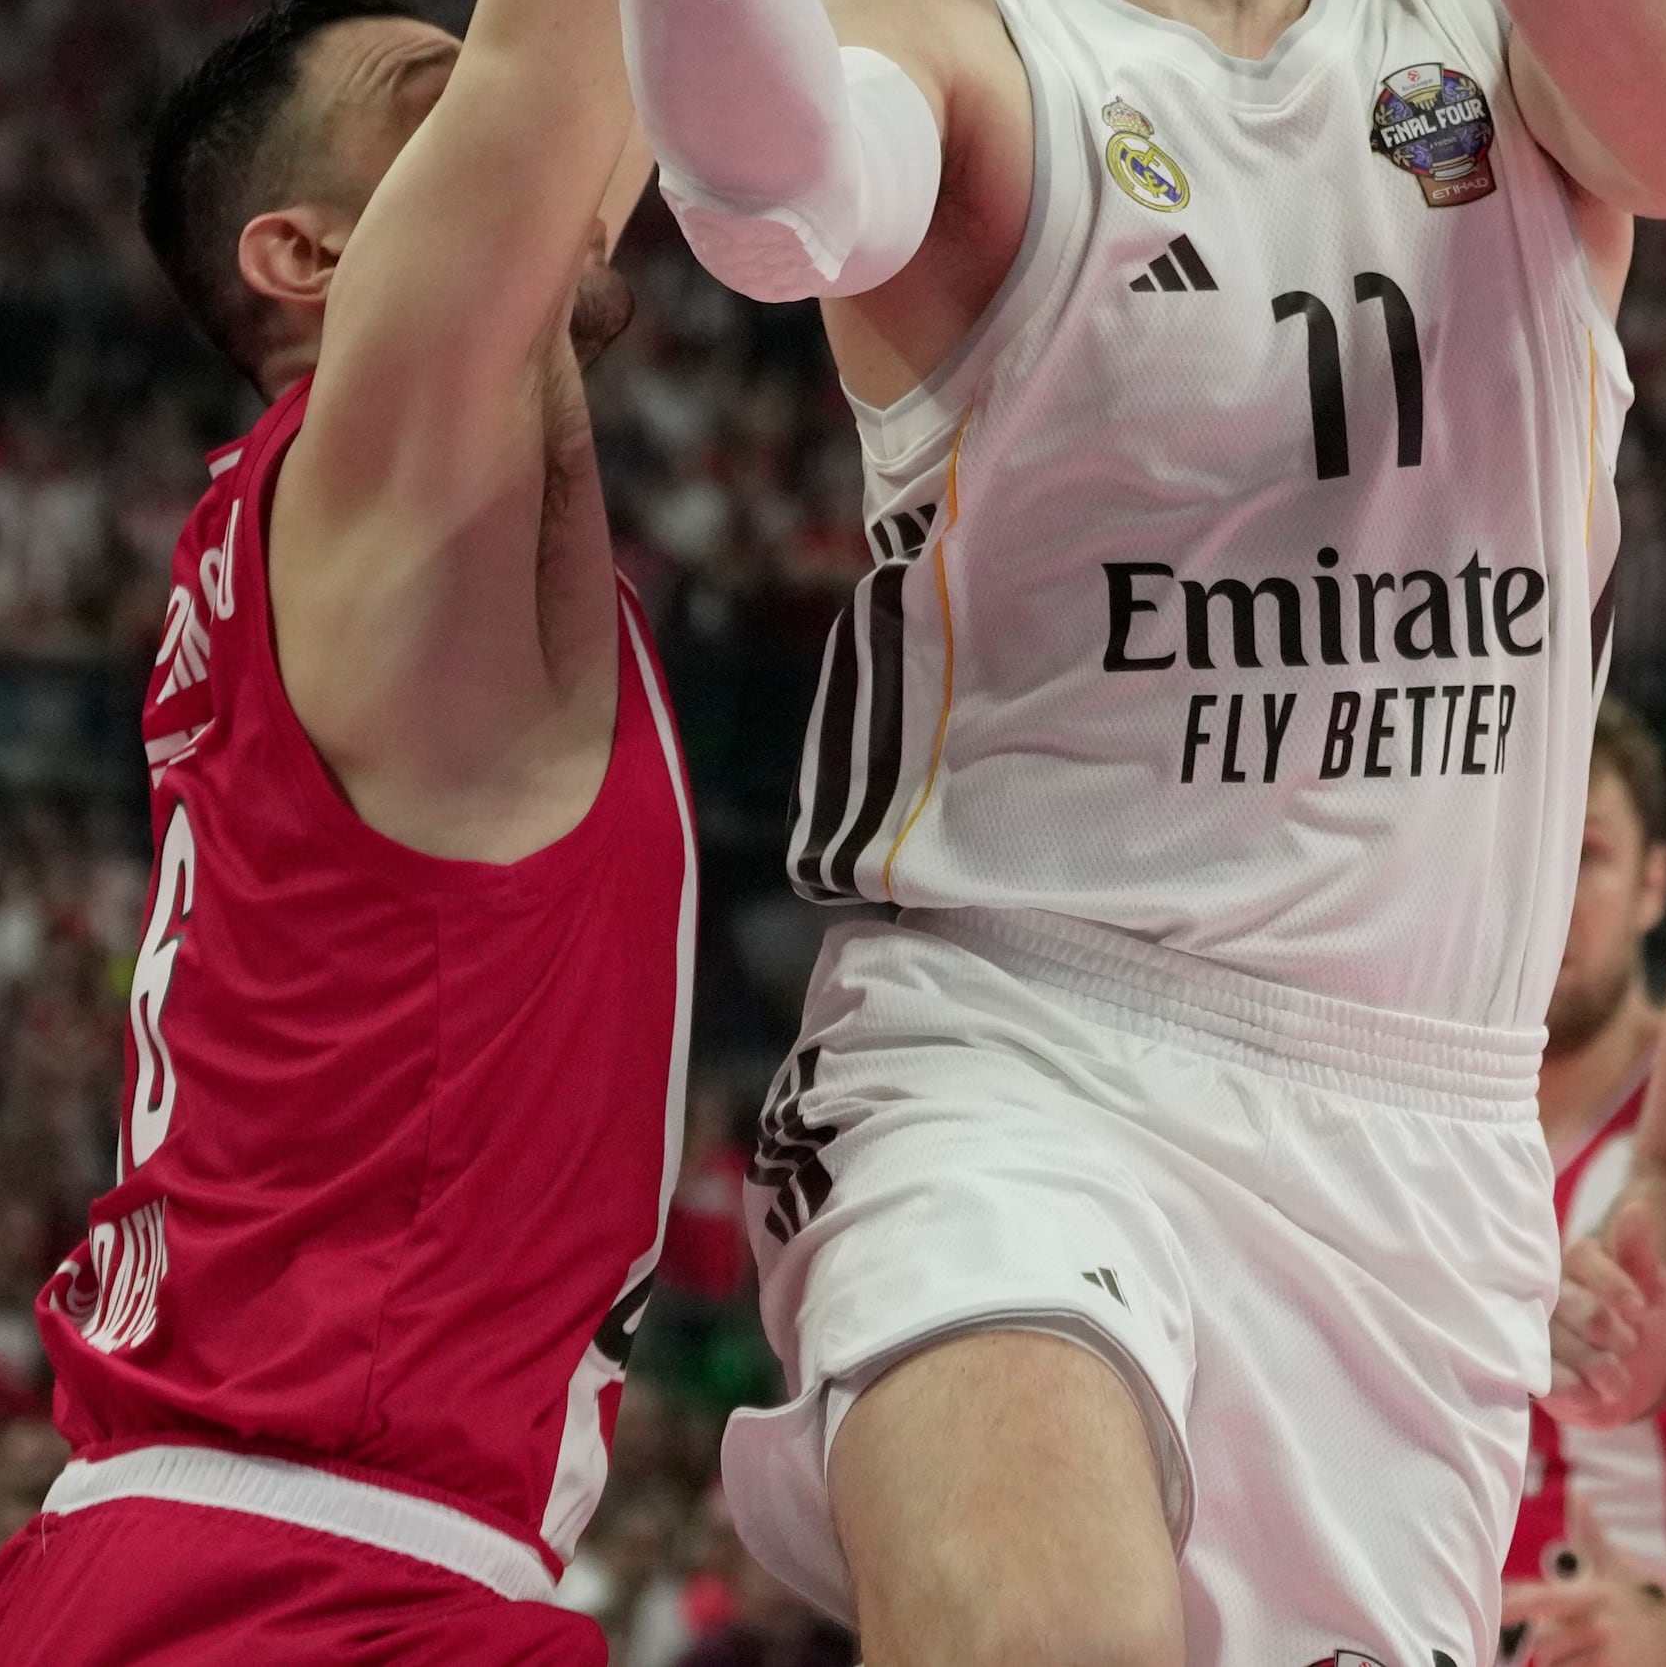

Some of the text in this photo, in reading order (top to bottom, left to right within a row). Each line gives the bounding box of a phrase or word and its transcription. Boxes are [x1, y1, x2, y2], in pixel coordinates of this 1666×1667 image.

[1381, 98, 1485, 148] FINAL FOUR
[1432, 178, 1489, 201] ETIHAD
[1272, 270, 1425, 481] 11
[1102, 547, 1550, 673] Emirate
[1180, 684, 1516, 785] FLY BETTER
